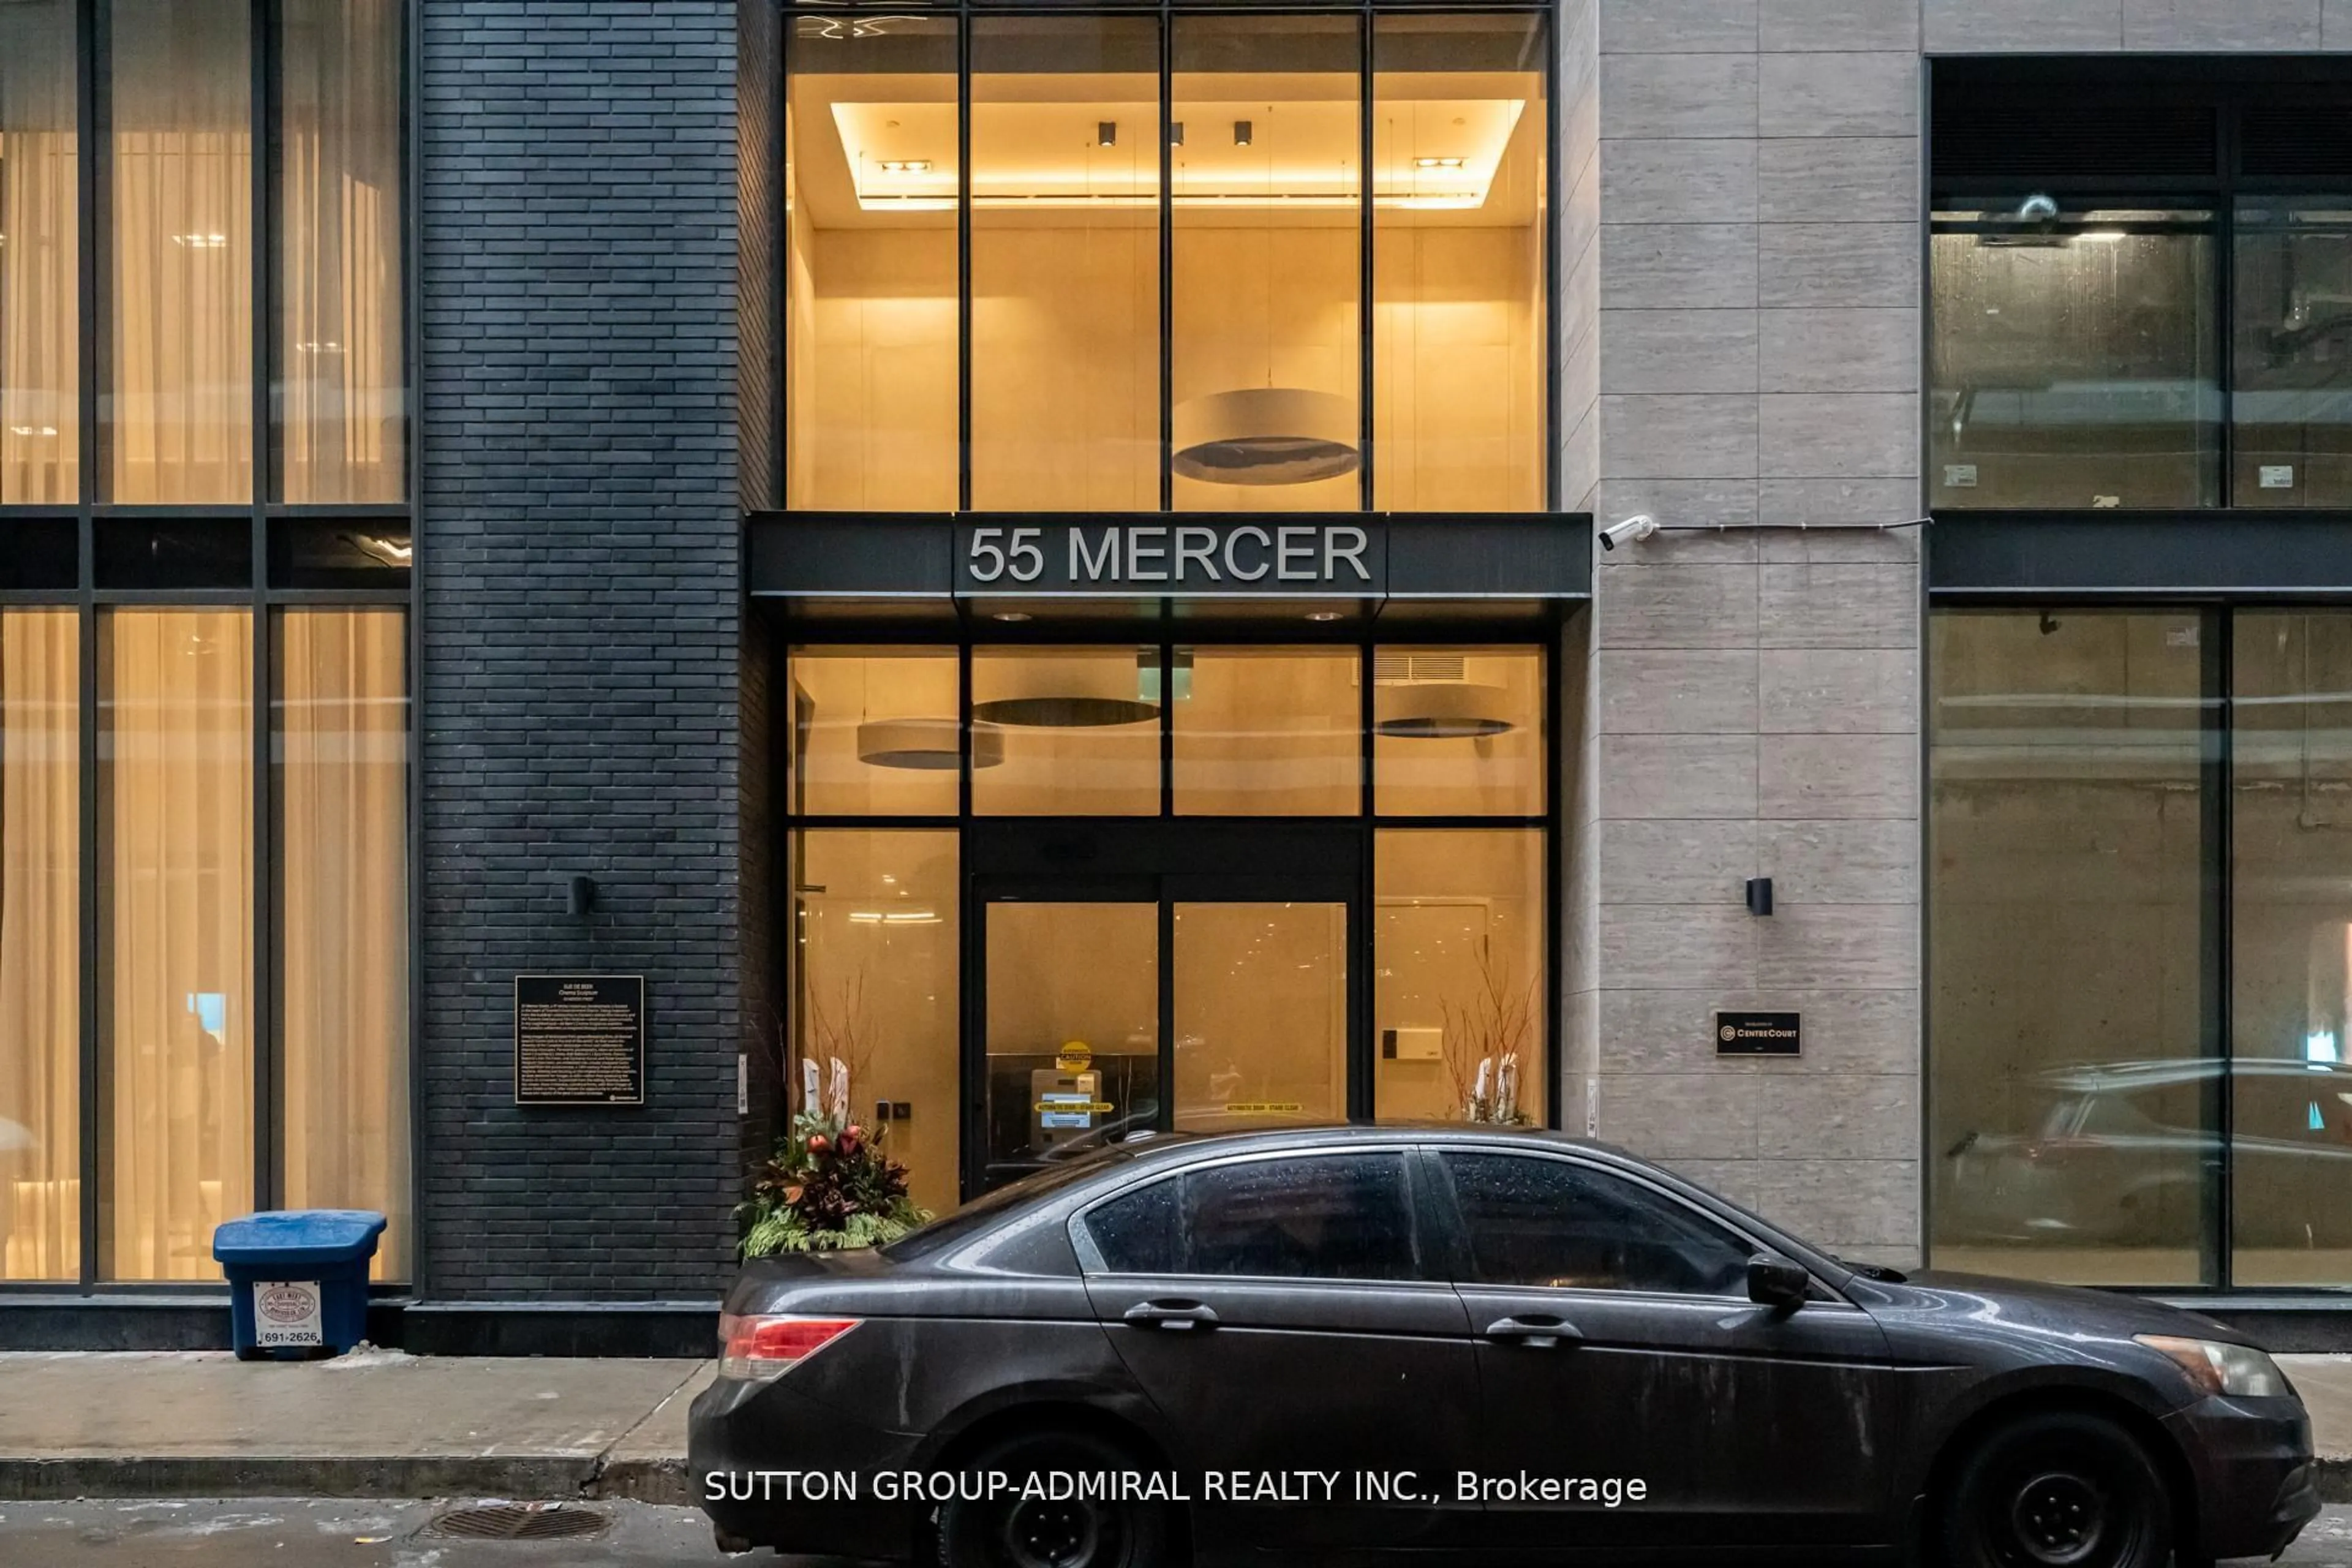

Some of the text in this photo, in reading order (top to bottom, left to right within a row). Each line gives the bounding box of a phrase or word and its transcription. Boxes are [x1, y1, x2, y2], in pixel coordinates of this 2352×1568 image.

[969, 526, 1371, 581] 55 MERCER
[265, 1333, 317, 1342] 691-2626
